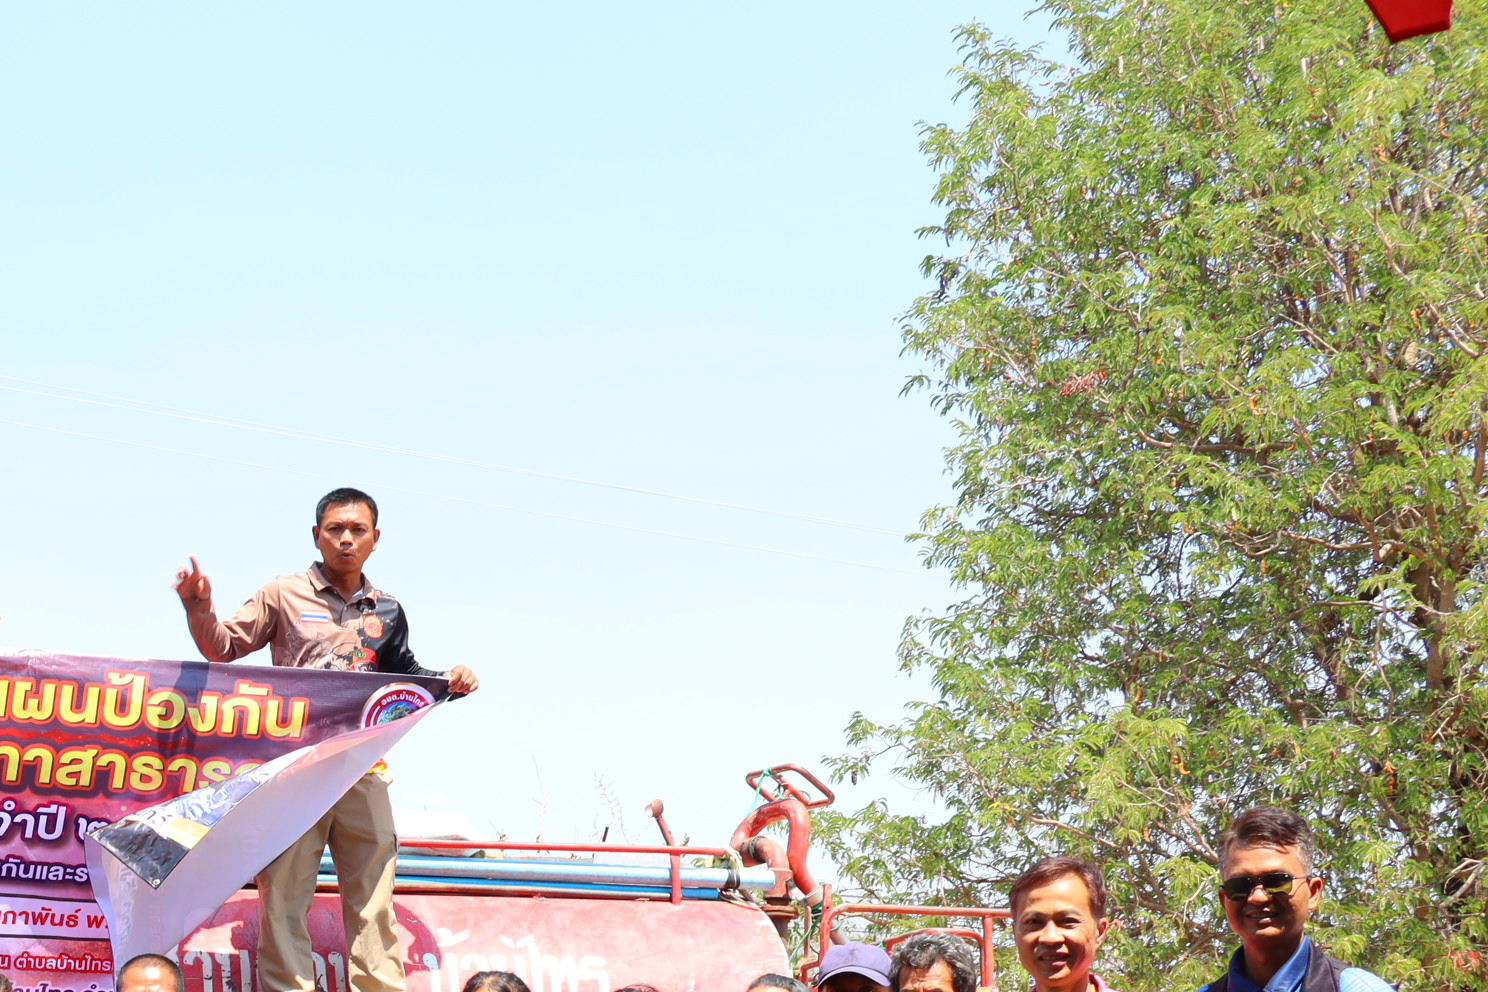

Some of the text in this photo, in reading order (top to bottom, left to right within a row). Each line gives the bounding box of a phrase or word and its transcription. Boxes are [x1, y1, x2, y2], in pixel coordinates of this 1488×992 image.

[15, 951, 112, 972] ตำบลบ้านไทร
